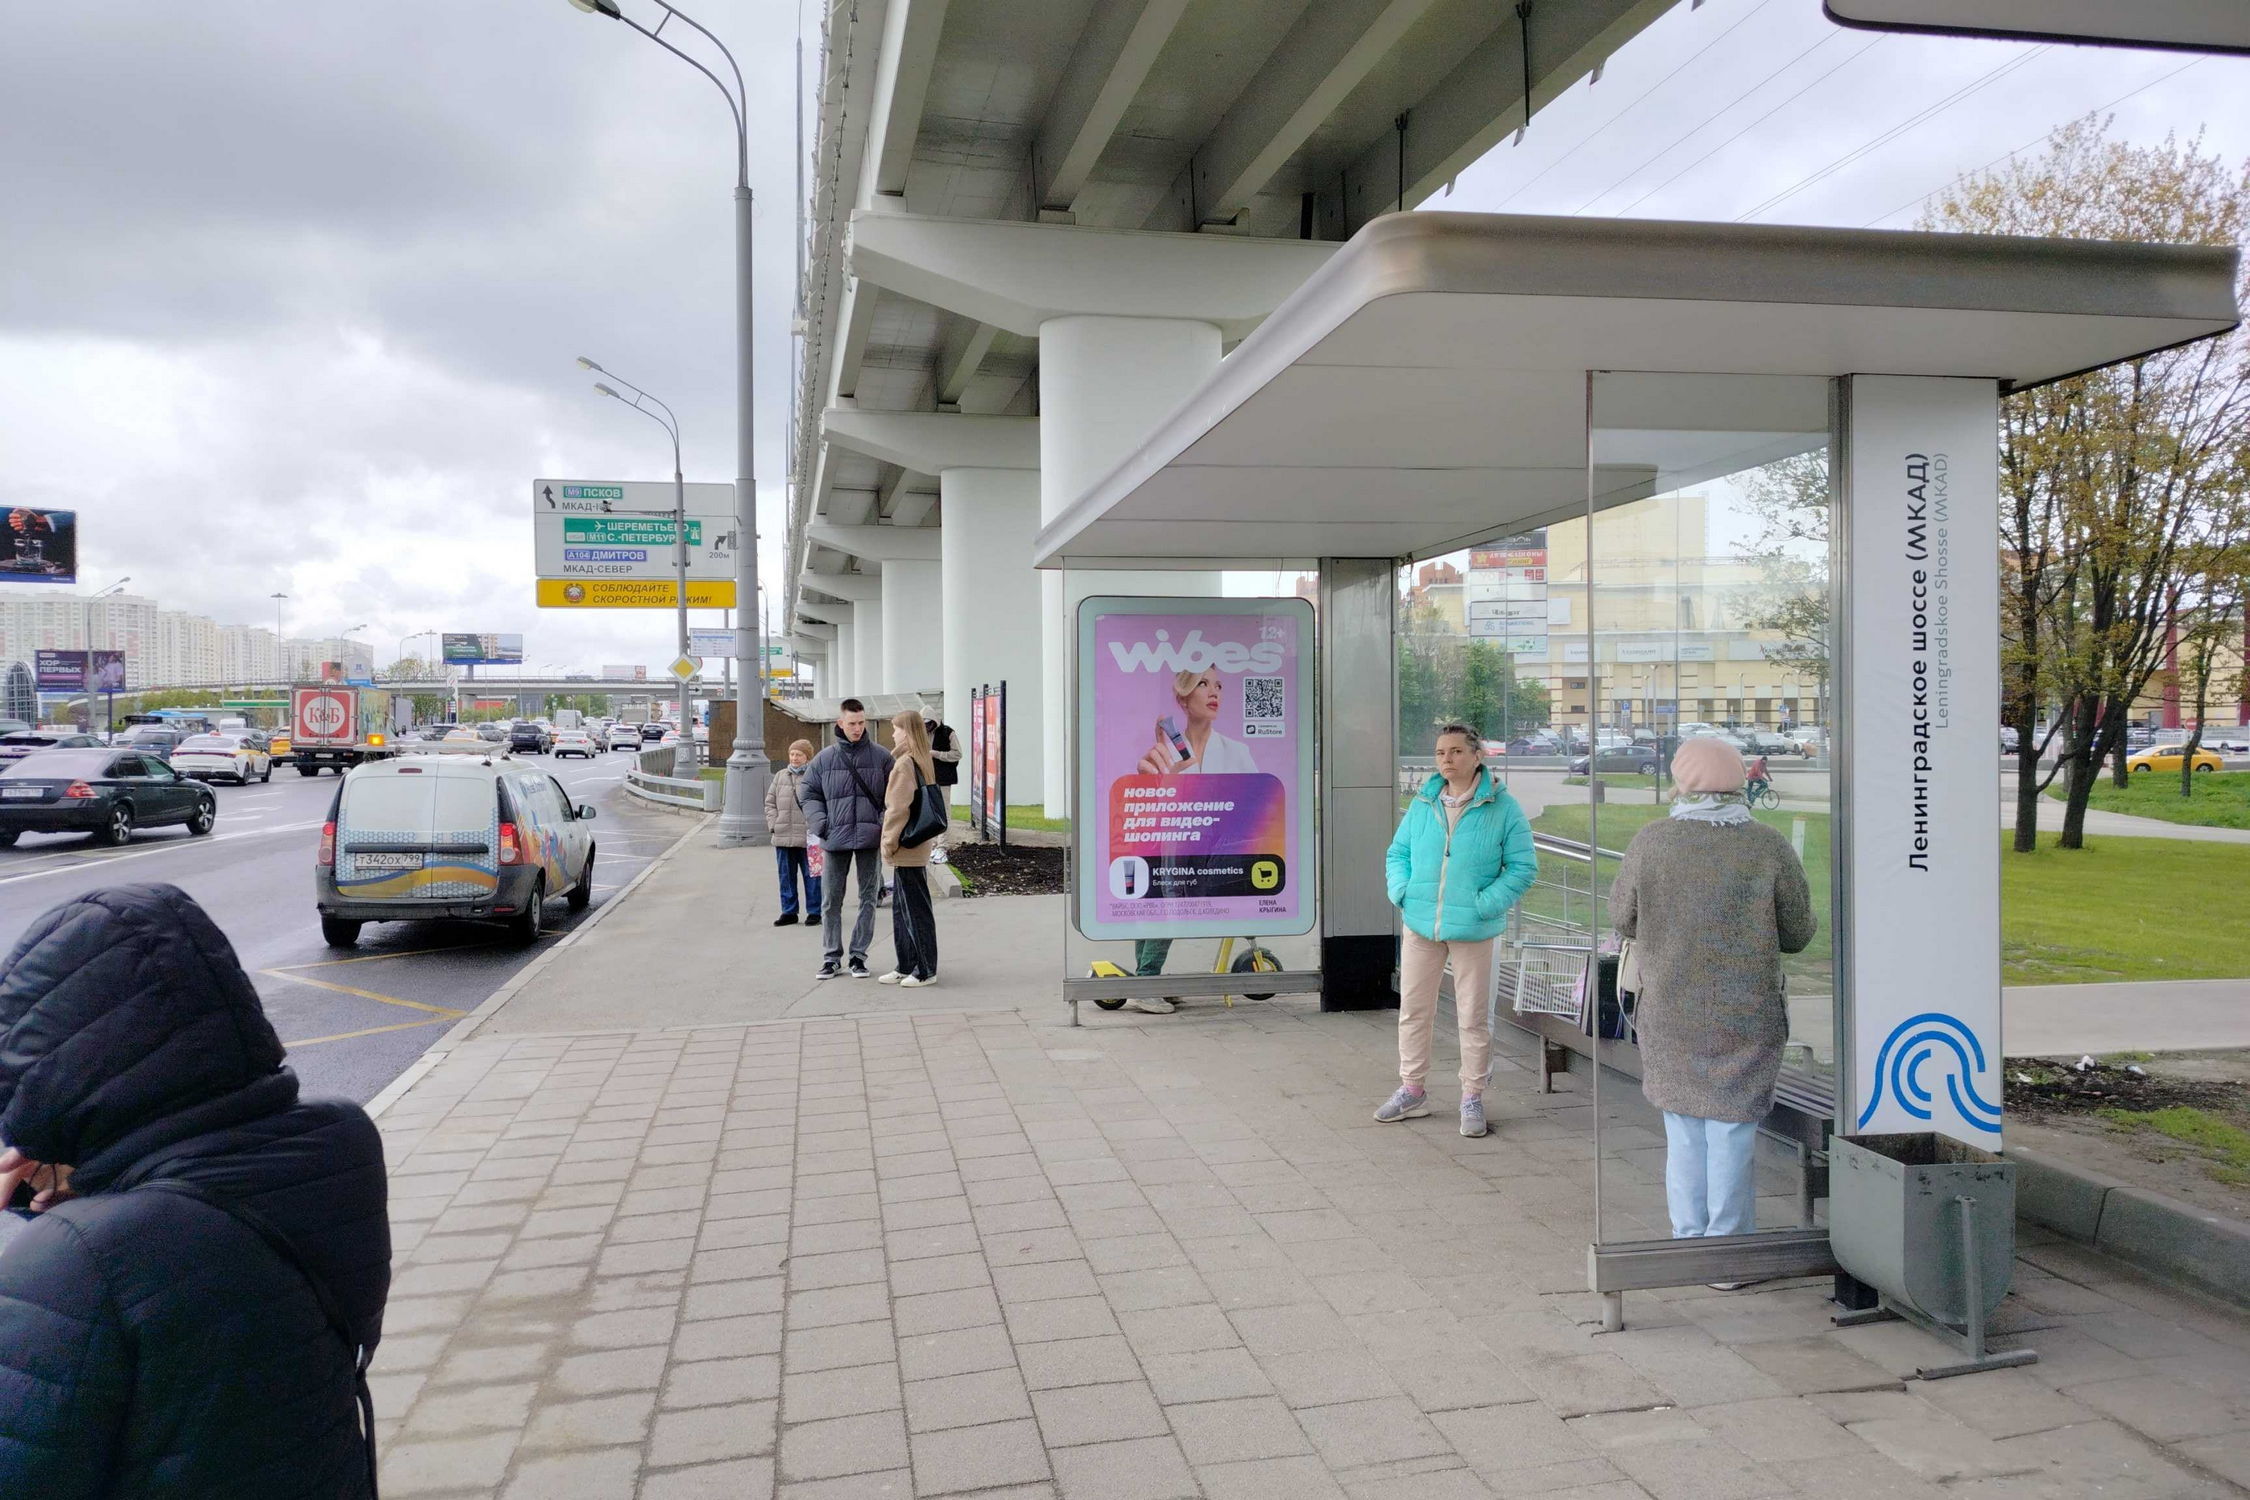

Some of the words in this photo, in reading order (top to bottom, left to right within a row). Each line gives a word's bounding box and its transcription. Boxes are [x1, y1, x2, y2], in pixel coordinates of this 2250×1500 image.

[583, 486, 621, 498] ПСКОВ
[1933, 453, 1948, 521] (MKAD)
[562, 502, 611, 512] МКАД-
[1905, 453, 1929, 561] (МКАД)
[607, 522, 689, 532] ШЕРЕМЕТЬЕО
[607, 533, 680, 543] С.-ПЕТЕРБУР
[592, 551, 645, 562] ДМИТРОВ
[709, 551, 730, 560] 200м
[1935, 527, 1948, 590] Shosse
[563, 564, 633, 575] МКАД-СЕВЕР
[592, 583, 670, 594] СОБЛЮДАЙТЕ
[593, 594, 667, 605] СКОРОСТНОЙ
[669, 596, 712, 605] РЖИМ!
[1912, 569, 1927, 651] шоссе
[1935, 594, 1952, 729] Leningradskoe
[1909, 660, 1932, 872] Ленинградское
[1123, 787, 1177, 798] новое
[1123, 800, 1234, 816] приложение
[1123, 816, 1156, 830] для
[1160, 816, 1220, 829] видео-
[1123, 831, 1201, 842] шопинга
[403, 854, 420, 863] 799
[1152, 867, 1195, 876] KRYGINA
[1197, 866, 1244, 875] cosmetics
[1186, 879, 1198, 887] губ
